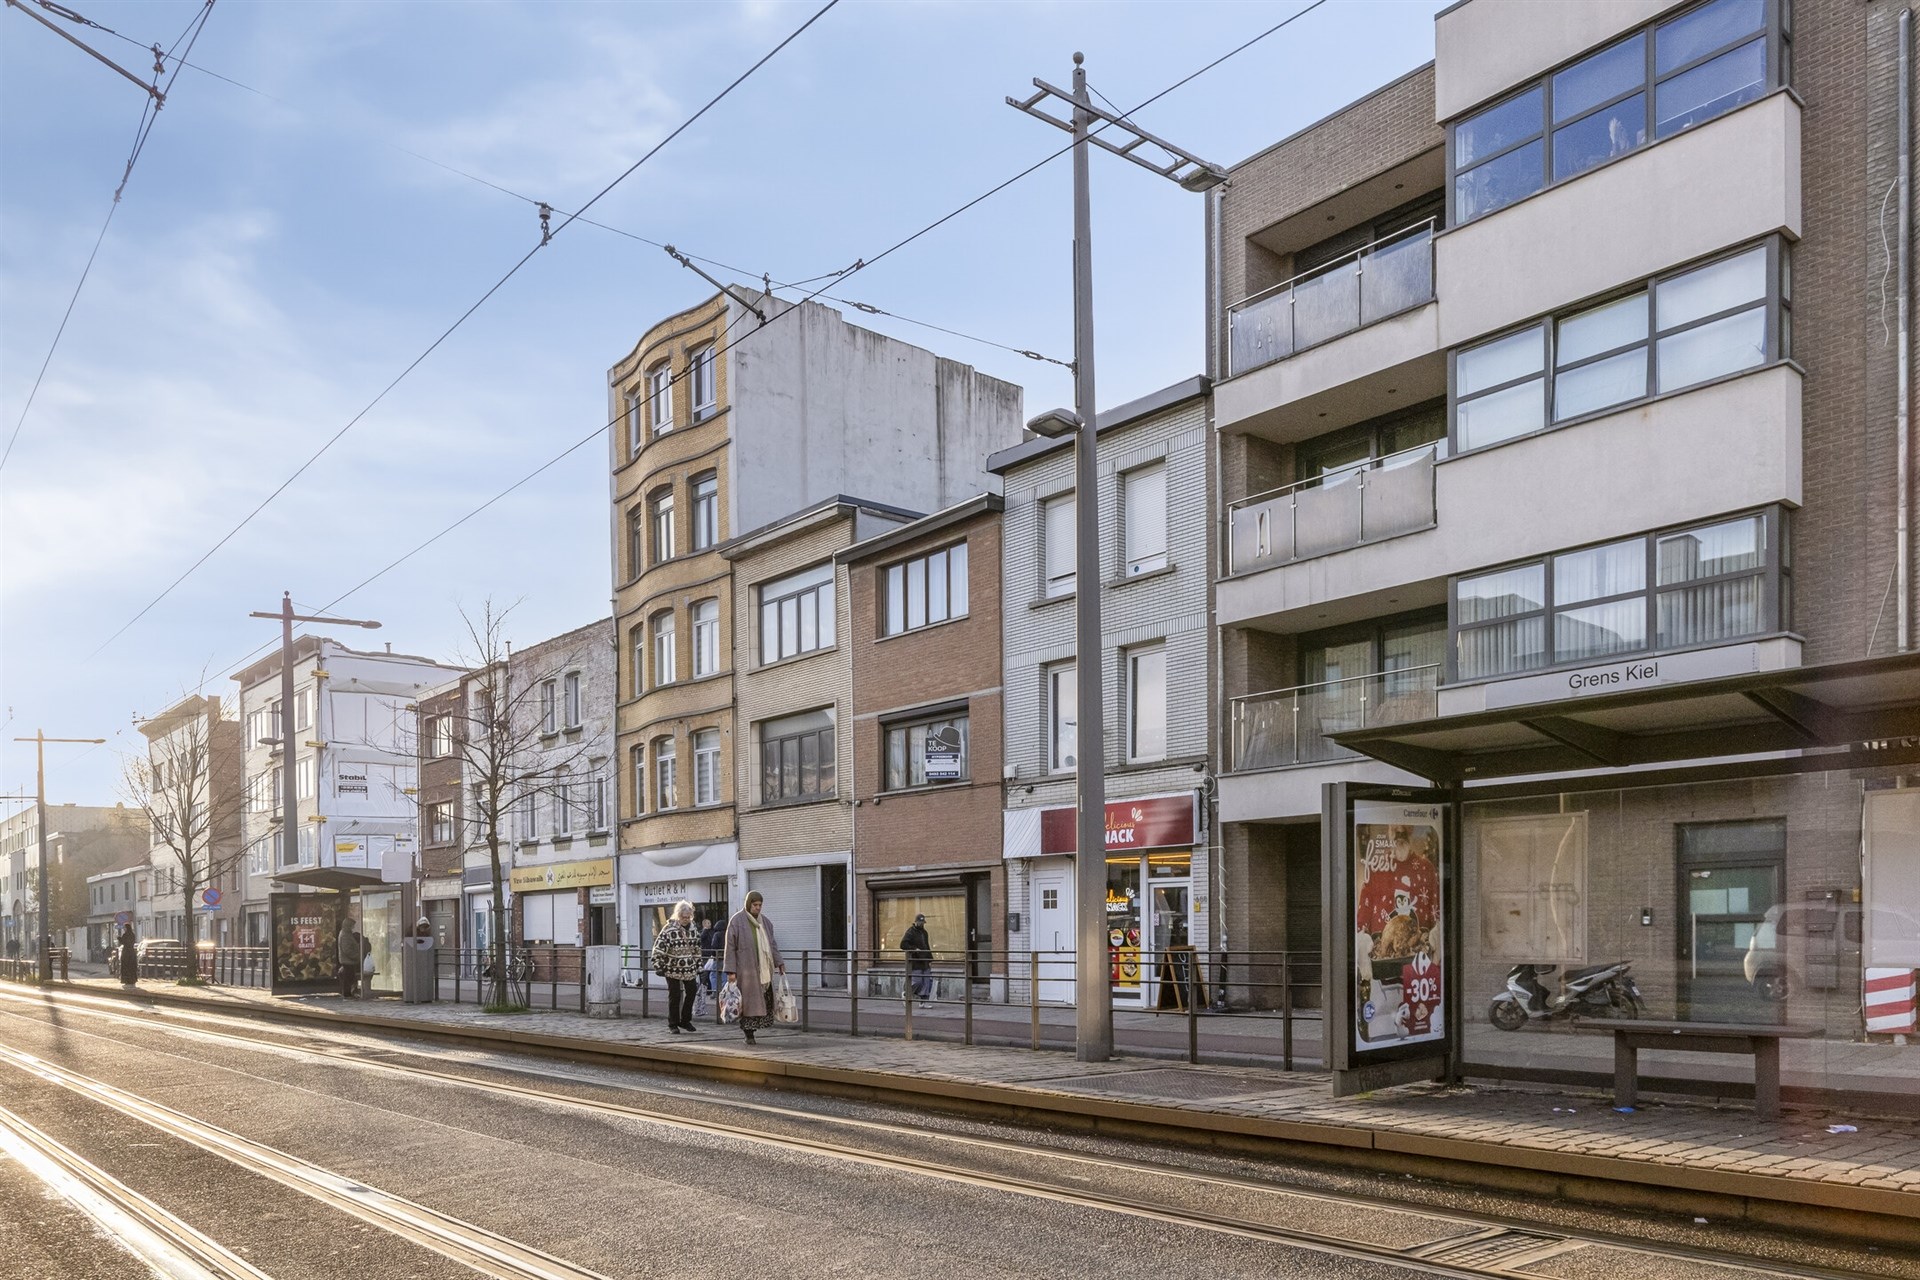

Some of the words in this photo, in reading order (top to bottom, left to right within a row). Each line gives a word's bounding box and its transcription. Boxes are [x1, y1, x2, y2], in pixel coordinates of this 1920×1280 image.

[1569, 672, 1620, 689] Grens
[1626, 662, 1658, 681] Kiel
[1104, 811, 1135, 830] elicious
[1403, 809, 1428, 818] Carrefour
[1104, 828, 1135, 844] NACK
[1375, 840, 1397, 848] SMAAK
[1360, 839, 1397, 884] feest
[644, 884, 665, 896] Outlet
[667, 884, 671, 894] R
[673, 883, 678, 894] &
[290, 917, 299, 925] IS
[300, 917, 322, 925] FEEST
[298, 934, 315, 943] 1+1
[1407, 977, 1437, 1003] -30%
